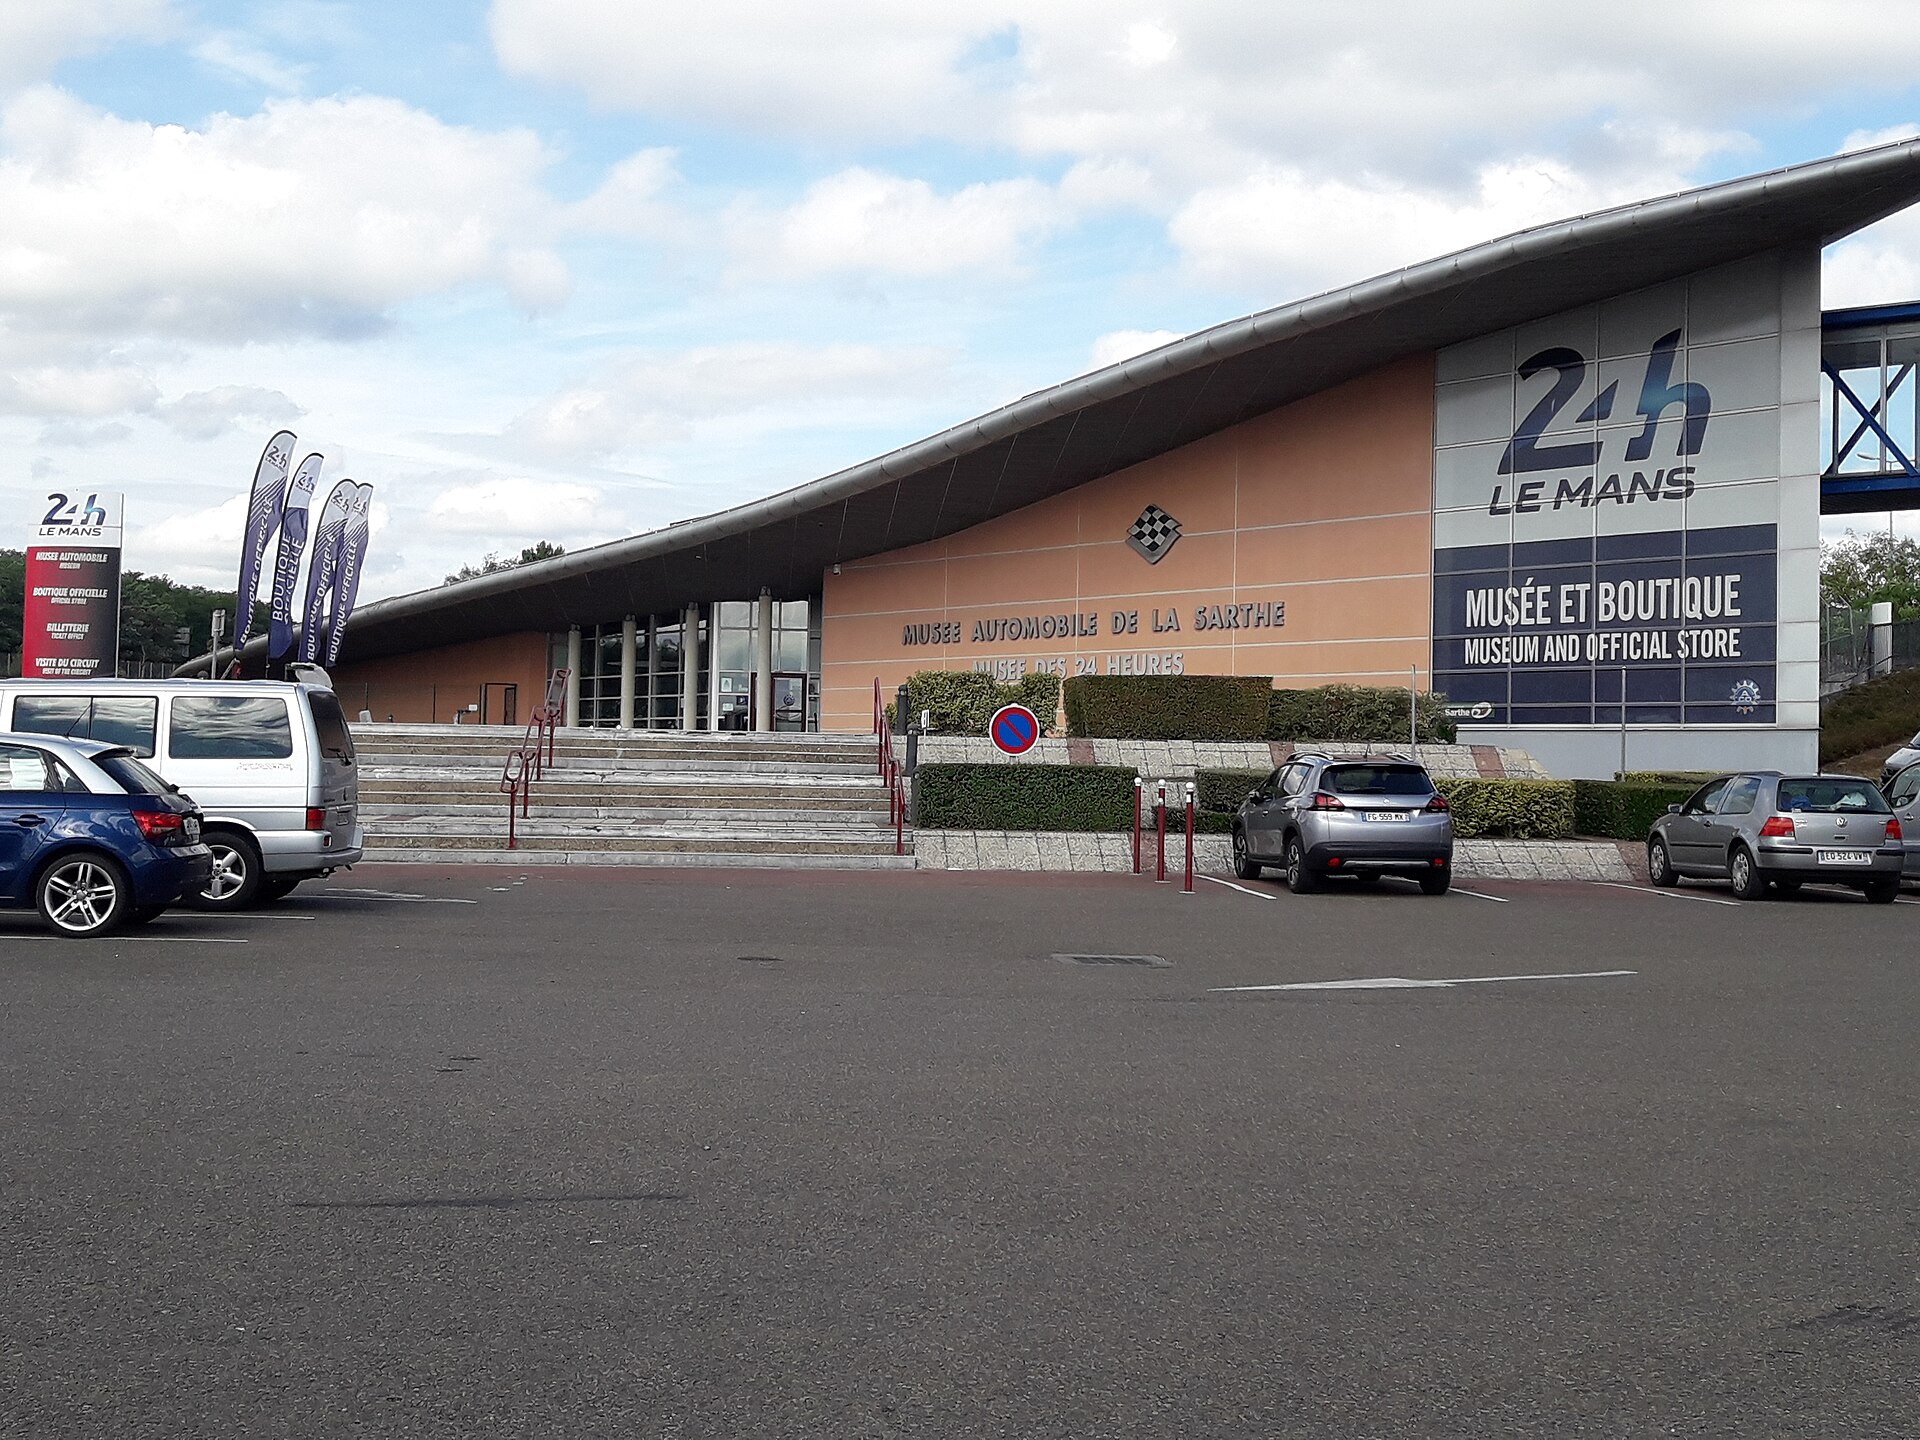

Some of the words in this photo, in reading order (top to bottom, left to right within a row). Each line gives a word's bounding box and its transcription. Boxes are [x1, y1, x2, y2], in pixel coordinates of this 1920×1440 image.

[1497, 328, 1712, 475] 24h
[1488, 481, 1545, 516] LE
[1553, 466, 1696, 510] MANS
[41, 493, 106, 526] 24h
[39, 527, 54, 536] LE
[57, 527, 102, 537] MANS
[35, 551, 59, 561] MUSEE
[59, 552, 108, 563] AUTOMOBILE
[32, 587, 69, 597] BOUTIQUE
[68, 588, 108, 599] OFFICIELLE
[272, 532, 291, 621] BOUTIQUE
[240, 572, 258, 644] BOUTIQUE
[329, 603, 347, 662] BOUTIQUE
[341, 540, 358, 602] OFFICIELLE
[1465, 577, 1551, 628] MUSÉE
[1559, 583, 1591, 624] ET
[1598, 574, 1741, 622] BOUTIQUE
[46, 622, 90, 633] BILLETTERIE
[902, 622, 961, 646] MUSEE
[971, 613, 1098, 643] AUTOMOBILE
[1112, 611, 1138, 635] DE
[1152, 608, 1181, 633] LA
[1194, 602, 1285, 631] SARTHE
[35, 658, 57, 667] VISITE
[57, 659, 70, 667] DU
[69, 659, 100, 669] CIRCUIT
[1075, 656, 1097, 676] 24
[1106, 652, 1185, 676] HEURES
[1464, 635, 1539, 665] MUSEUM
[1543, 634, 1580, 662] AND
[1586, 630, 1672, 661] OFFICIAL
[1677, 628, 1741, 658] STORE
[1444, 708, 1470, 717] Sarthe
